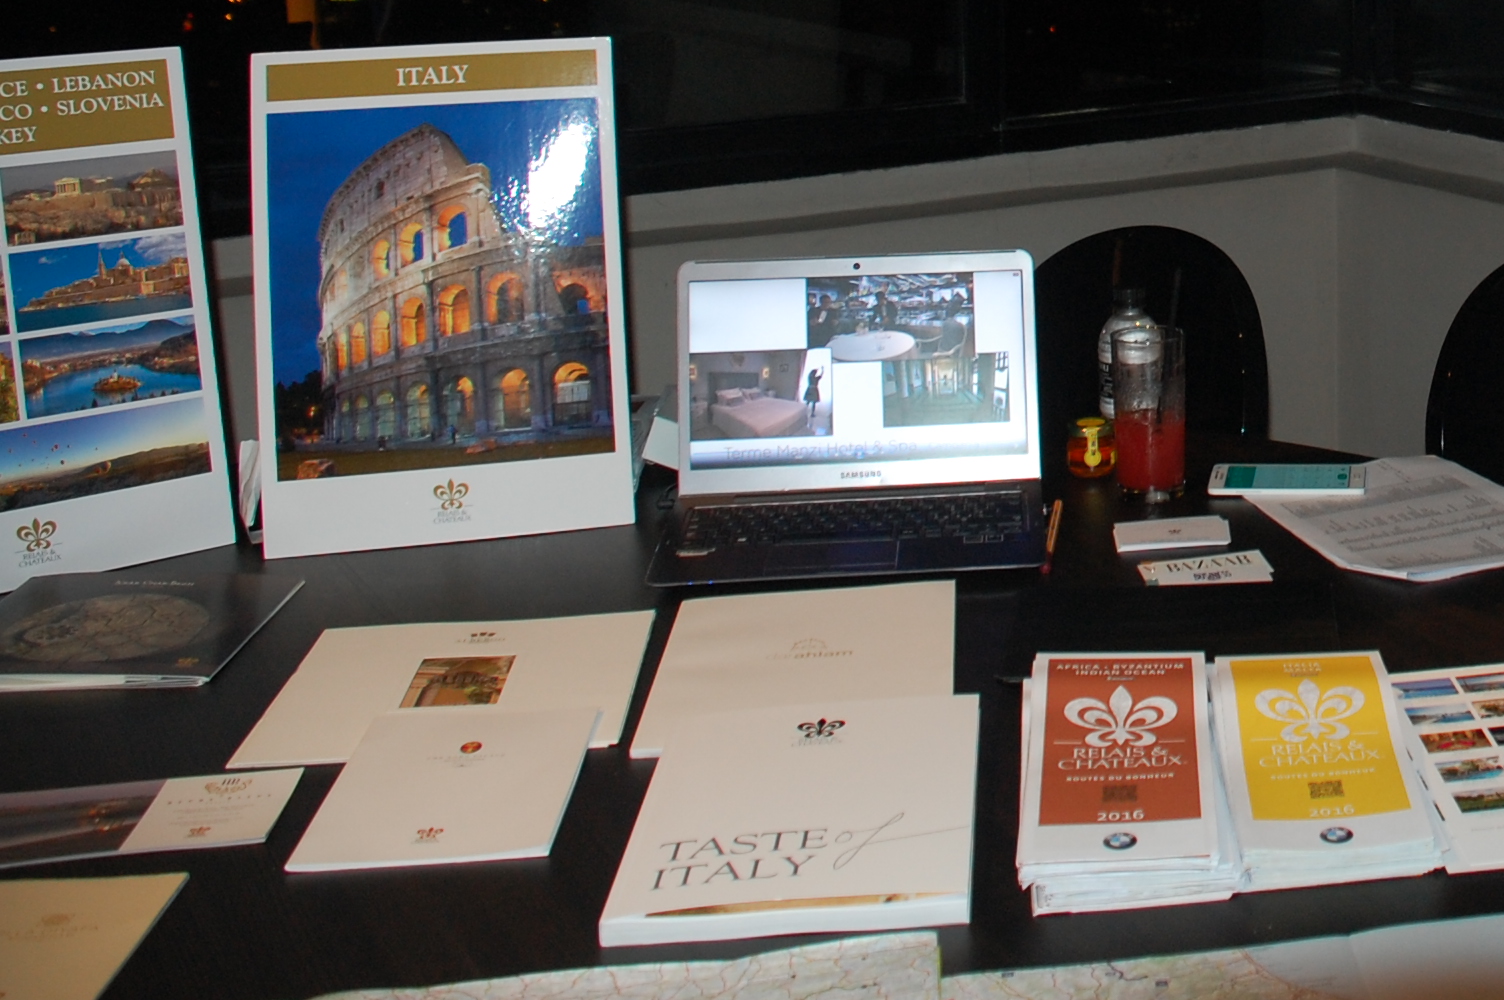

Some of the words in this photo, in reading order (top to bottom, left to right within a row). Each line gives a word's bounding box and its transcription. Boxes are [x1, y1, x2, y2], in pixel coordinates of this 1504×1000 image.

[53, 70, 155, 93] LEBANON
[396, 64, 469, 86] ITALY
[57, 93, 164, 116] SLOVENIA
[724, 446, 771, 460] Terme
[826, 440, 868, 456] Hotel
[872, 440, 883, 454] &
[888, 439, 917, 454] Spa
[840, 470, 882, 479] SAMSUNG
[1166, 555, 1252, 573] BAZAAR
[1112, 662, 1185, 670] BYZANTIUM
[1073, 747, 1145, 759] RELAIS
[1150, 746, 1168, 757] &
[1271, 742, 1342, 756] RELAIS
[1347, 740, 1365, 751] &
[1057, 756, 1183, 770] CHATEAUX
[1259, 750, 1381, 767] CHATEAUX
[1097, 809, 1145, 822] 2016
[1309, 804, 1355, 818] 2016
[660, 828, 828, 864] TASTE
[650, 854, 817, 891] ITALY
